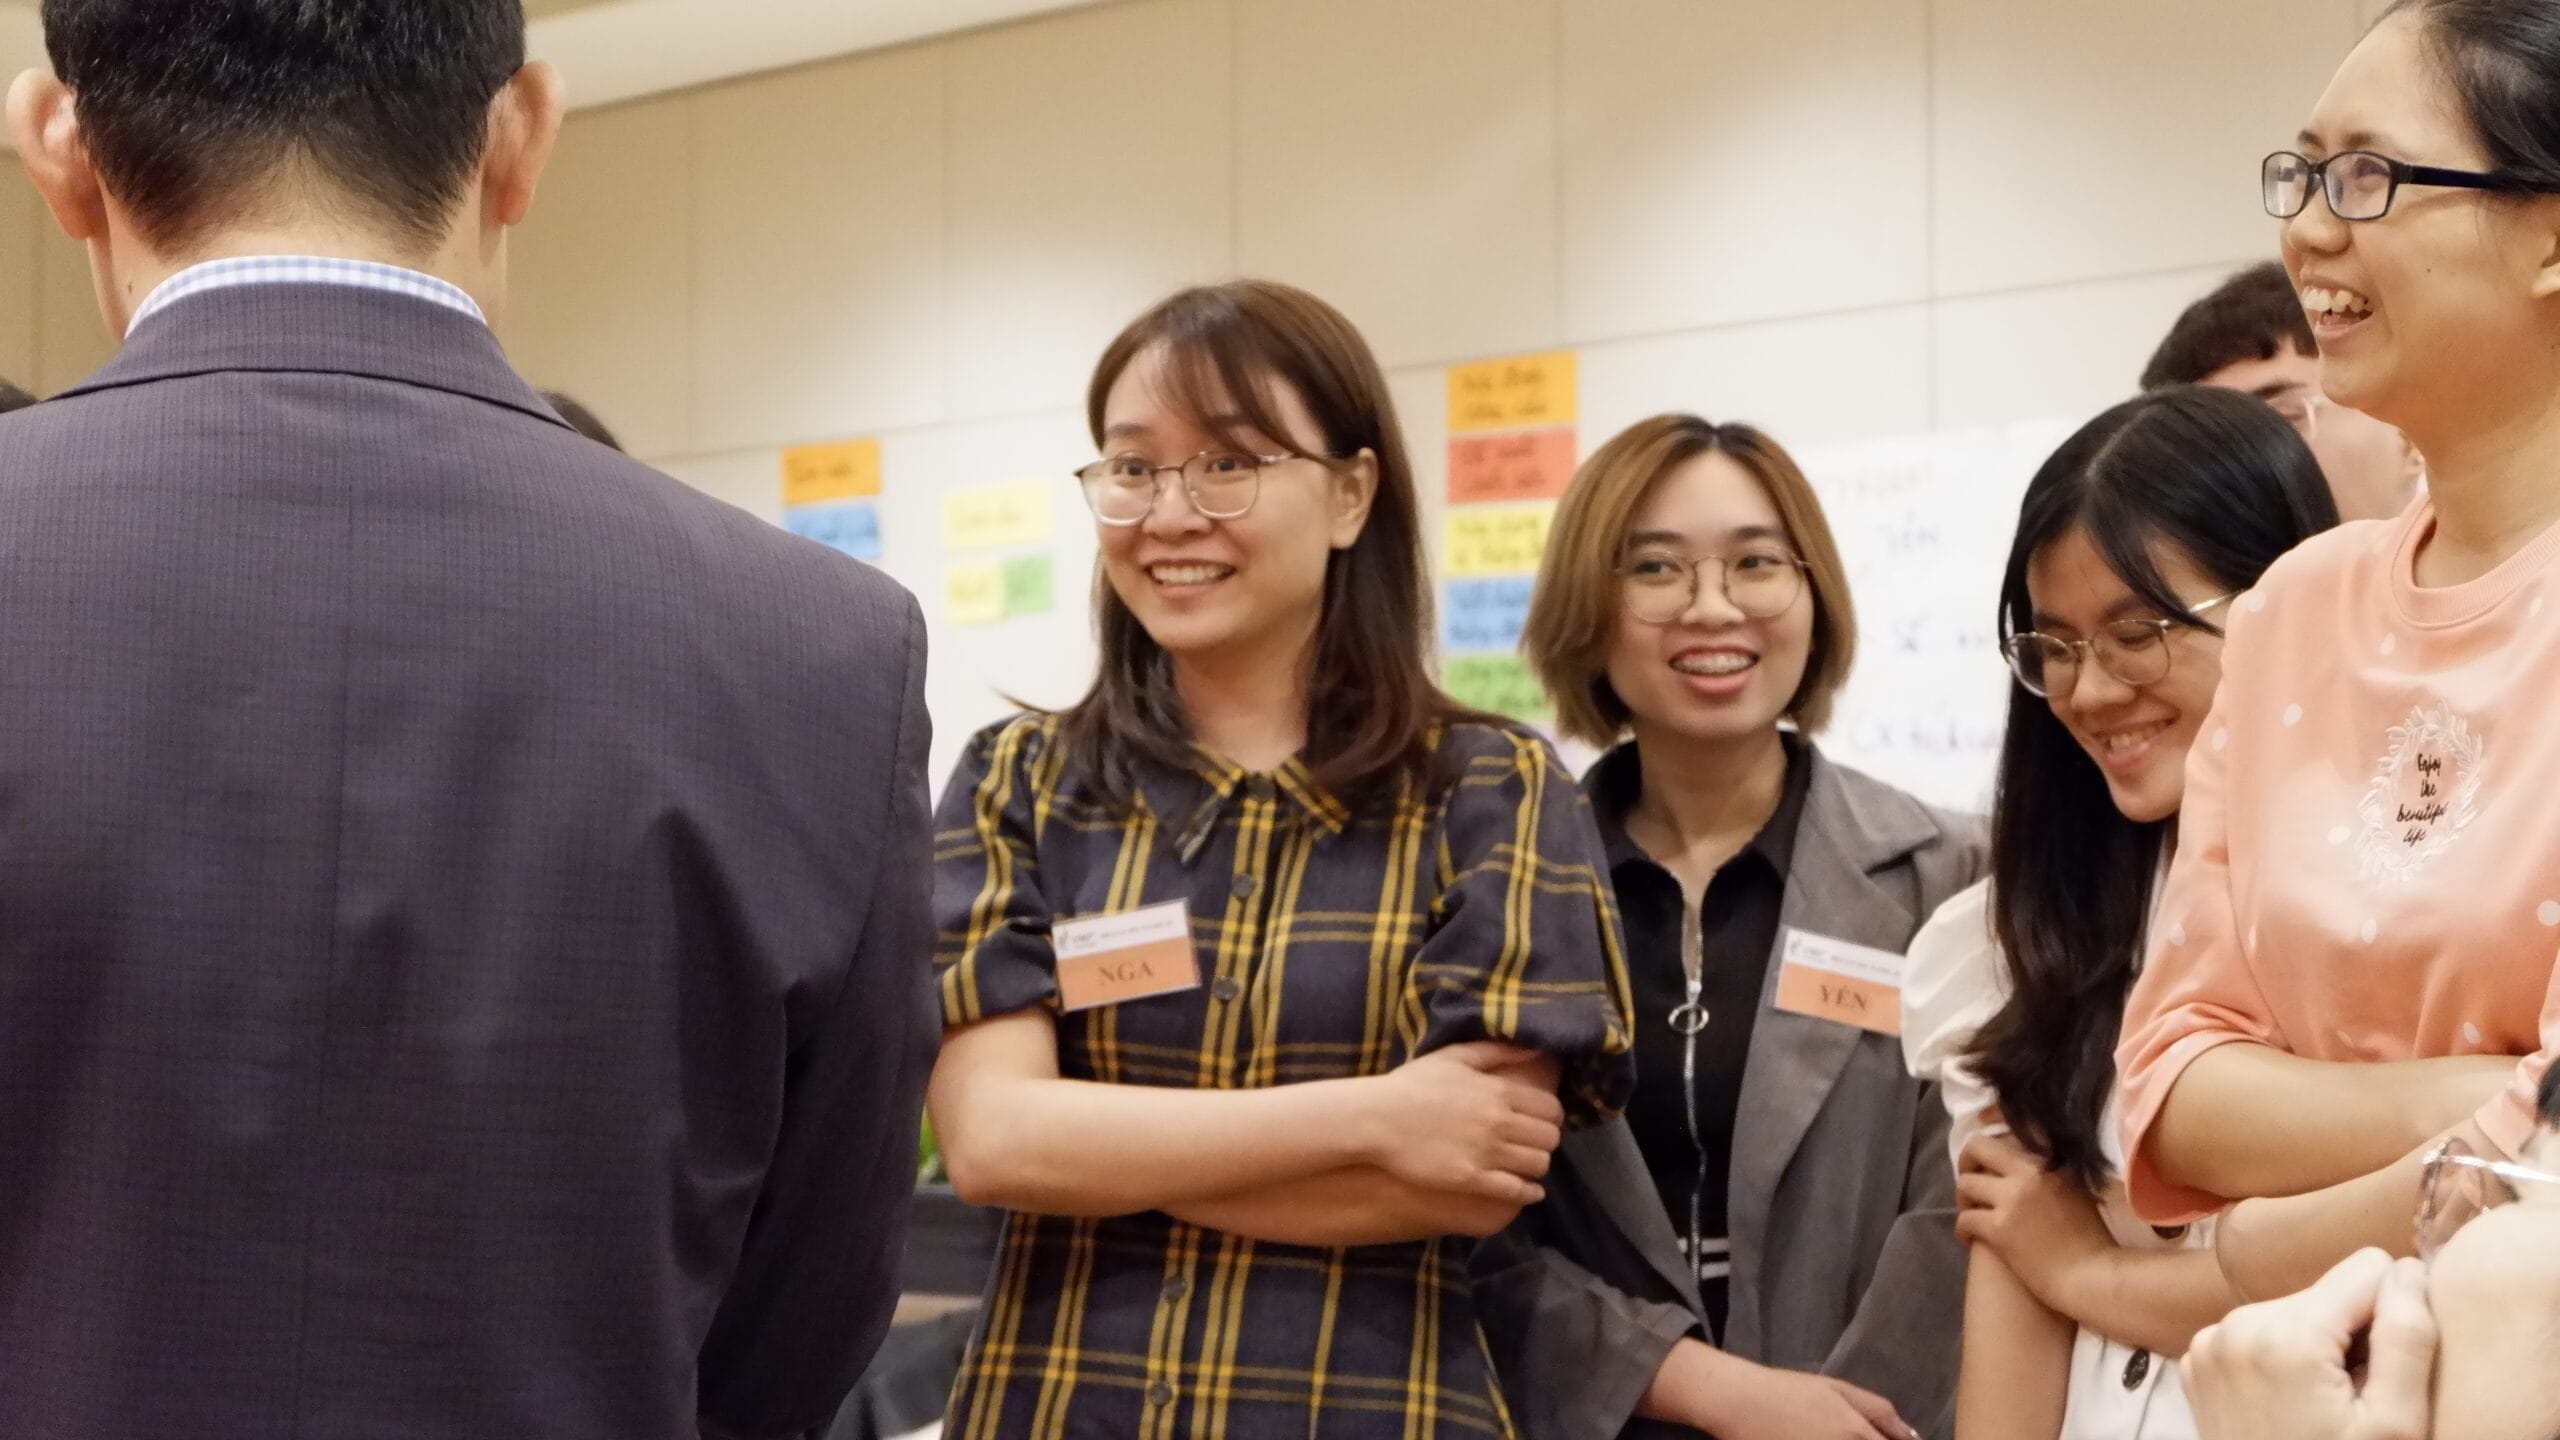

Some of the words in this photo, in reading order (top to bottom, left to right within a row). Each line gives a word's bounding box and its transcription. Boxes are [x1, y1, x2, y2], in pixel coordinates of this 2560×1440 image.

[2417, 753, 2442, 777] Enjoy
[2420, 779, 2437, 798] the
[2402, 827, 2427, 847] life
[1098, 960, 1154, 986] NGA
